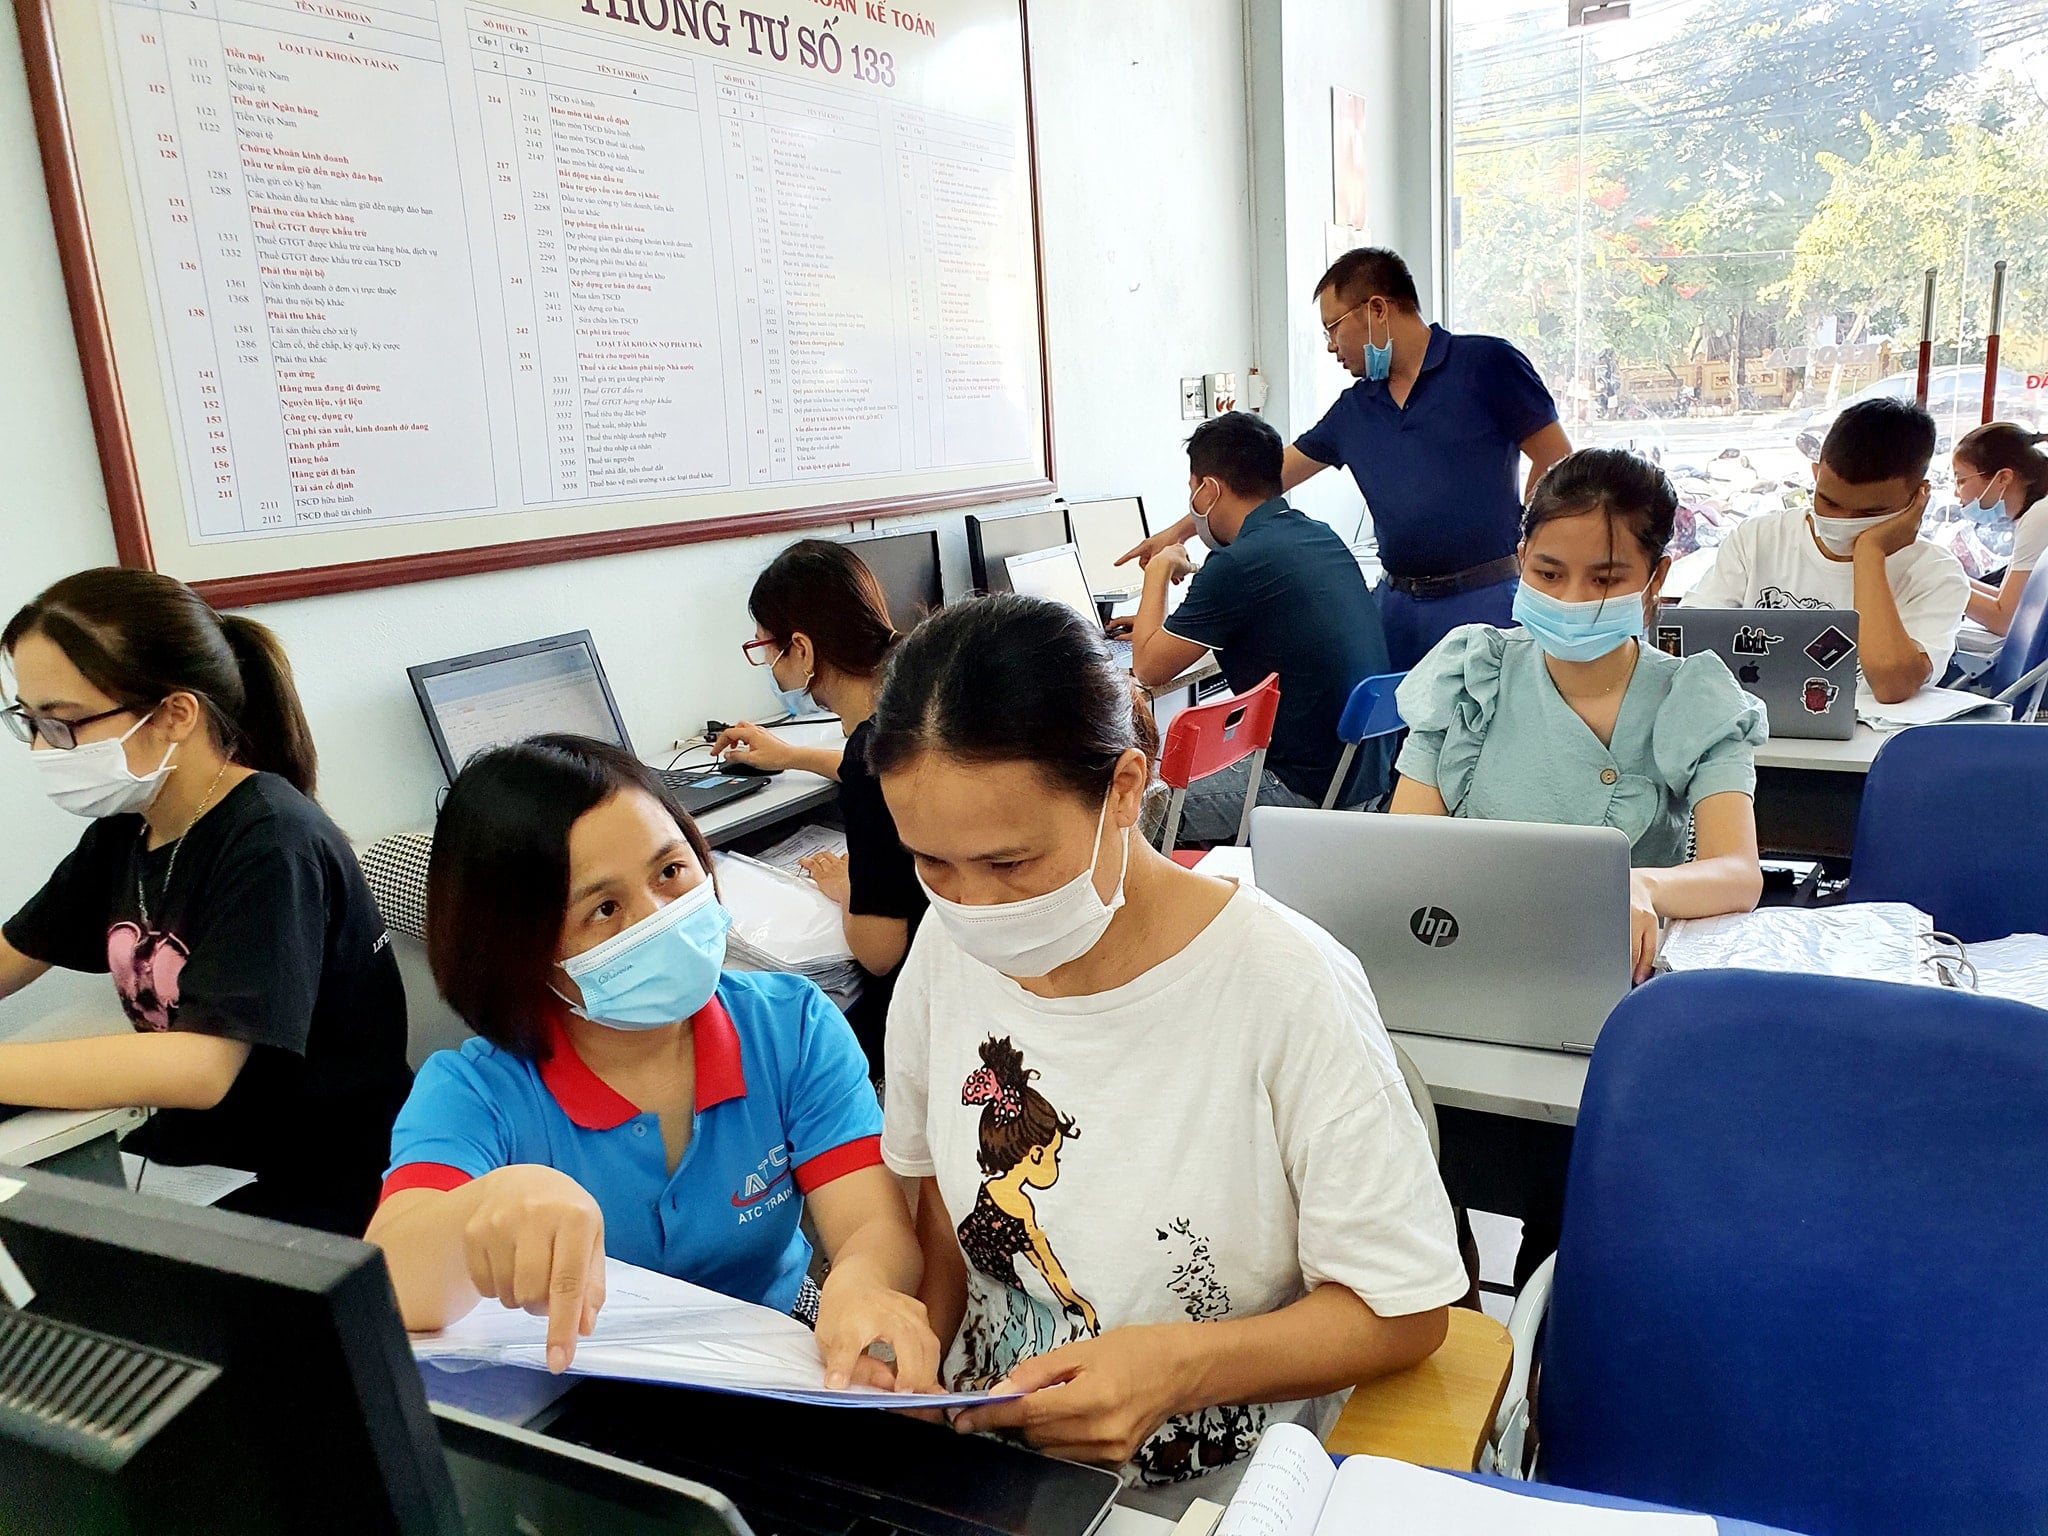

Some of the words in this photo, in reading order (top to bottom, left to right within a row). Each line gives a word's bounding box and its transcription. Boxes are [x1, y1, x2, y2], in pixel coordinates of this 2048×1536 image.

[188, 0, 197, 10] 3
[866, 0, 887, 24] KẾ
[891, 9, 936, 38] TOÁN
[347, 31, 355, 40] 4
[516, 26, 528, 37] TK
[140, 33, 156, 45] 111
[524, 45, 529, 53] 2
[740, 9, 790, 61] TƯ
[797, 16, 843, 75] SỐ
[851, 44, 897, 88] 133
[492, 60, 499, 69] 2
[267, 69, 290, 82] Nam
[526, 67, 532, 75] 3
[190, 72, 212, 85] 1112
[148, 83, 165, 94] 112
[519, 87, 536, 97] 2113
[487, 94, 501, 104] 214
[195, 105, 217, 117] 1121
[522, 113, 539, 124] 2141
[198, 121, 220, 133] 1122
[524, 126, 542, 136] 2142
[156, 133, 174, 143] 121
[525, 138, 543, 149] 2143
[301, 150, 322, 160] kinh
[322, 153, 350, 164] doanh
[527, 152, 545, 161] 2147
[496, 160, 509, 169] 217
[207, 169, 228, 180] 1281
[497, 174, 512, 182] 228
[209, 185, 232, 196] 1288
[532, 190, 549, 200] 2281
[168, 197, 185, 207] 131
[533, 203, 551, 211] 2288
[272, 207, 288, 216] thu
[171, 213, 188, 223] 133
[502, 213, 516, 221] 229
[277, 222, 307, 232] GTGT
[217, 232, 239, 242] 1331
[536, 228, 553, 237] 2291
[538, 240, 555, 249] 2292
[220, 247, 241, 258] 1332
[539, 253, 556, 262] 2293
[179, 261, 197, 271] 136
[282, 266, 298, 276] thu
[540, 265, 558, 273] 2294
[225, 279, 246, 288] 1361
[510, 276, 523, 285] 241
[227, 294, 250, 303] 1368
[543, 290, 560, 299] 2411
[545, 303, 562, 311] 2412
[288, 311, 304, 320] thu
[546, 315, 563, 323] 2413
[233, 324, 253, 334] 1381
[516, 327, 529, 335] 242
[235, 339, 257, 349] 1386
[237, 354, 259, 364] 1388
[198, 370, 214, 379] 141
[200, 385, 217, 394] 151
[202, 400, 219, 409] 152
[206, 415, 222, 424] 153
[208, 430, 225, 439] 154
[211, 445, 227, 454] 155
[213, 460, 230, 469] 156
[215, 474, 231, 484] 157
[217, 489, 233, 499] 211
[259, 500, 279, 510] 2111
[261, 514, 282, 524] 2112
[1416, 905, 1453, 948] hp
[372, 931, 390, 954] LIFE
[744, 1143, 789, 1197] ATC
[738, 1206, 763, 1225] ATC
